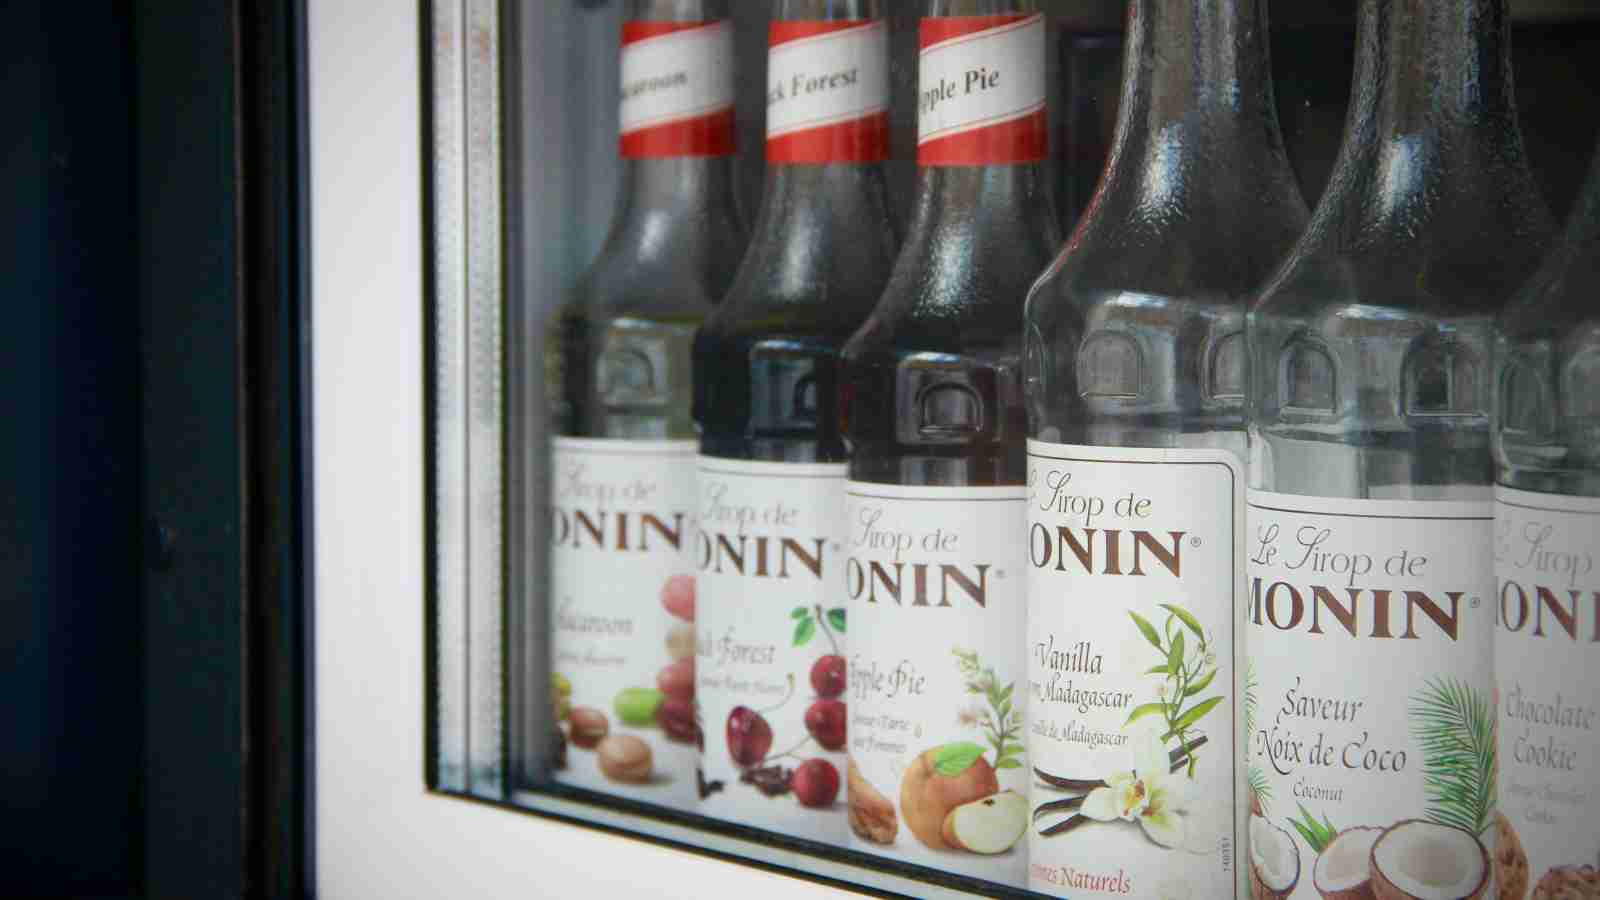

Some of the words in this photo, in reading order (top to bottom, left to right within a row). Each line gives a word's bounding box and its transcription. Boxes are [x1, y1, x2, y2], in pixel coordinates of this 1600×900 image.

[791, 68, 858, 97] Forest
[964, 67, 999, 94] Pie
[1040, 470, 1105, 527] Sirop
[1114, 492, 1151, 518] de
[852, 507, 912, 560] Sirop
[922, 528, 958, 552] de
[1251, 523, 1280, 565] Le
[1284, 526, 1373, 586] Sirop
[1385, 551, 1427, 576] de
[1514, 521, 1592, 588] Sirop
[716, 624, 775, 667] Forest
[1034, 634, 1103, 674] Vanilla
[887, 659, 925, 697] Pie
[1041, 672, 1133, 714] Madagascar
[1276, 676, 1363, 725] Saveur
[1505, 679, 1596, 729] Chocolate
[1058, 720, 1129, 749] Madagascar
[1257, 726, 1304, 775] Noix
[1309, 733, 1335, 767] de
[1342, 731, 1407, 773] Coco
[1513, 728, 1577, 771] Cookie
[1293, 776, 1344, 802] Coconut
[1060, 867, 1131, 893] Naturels
